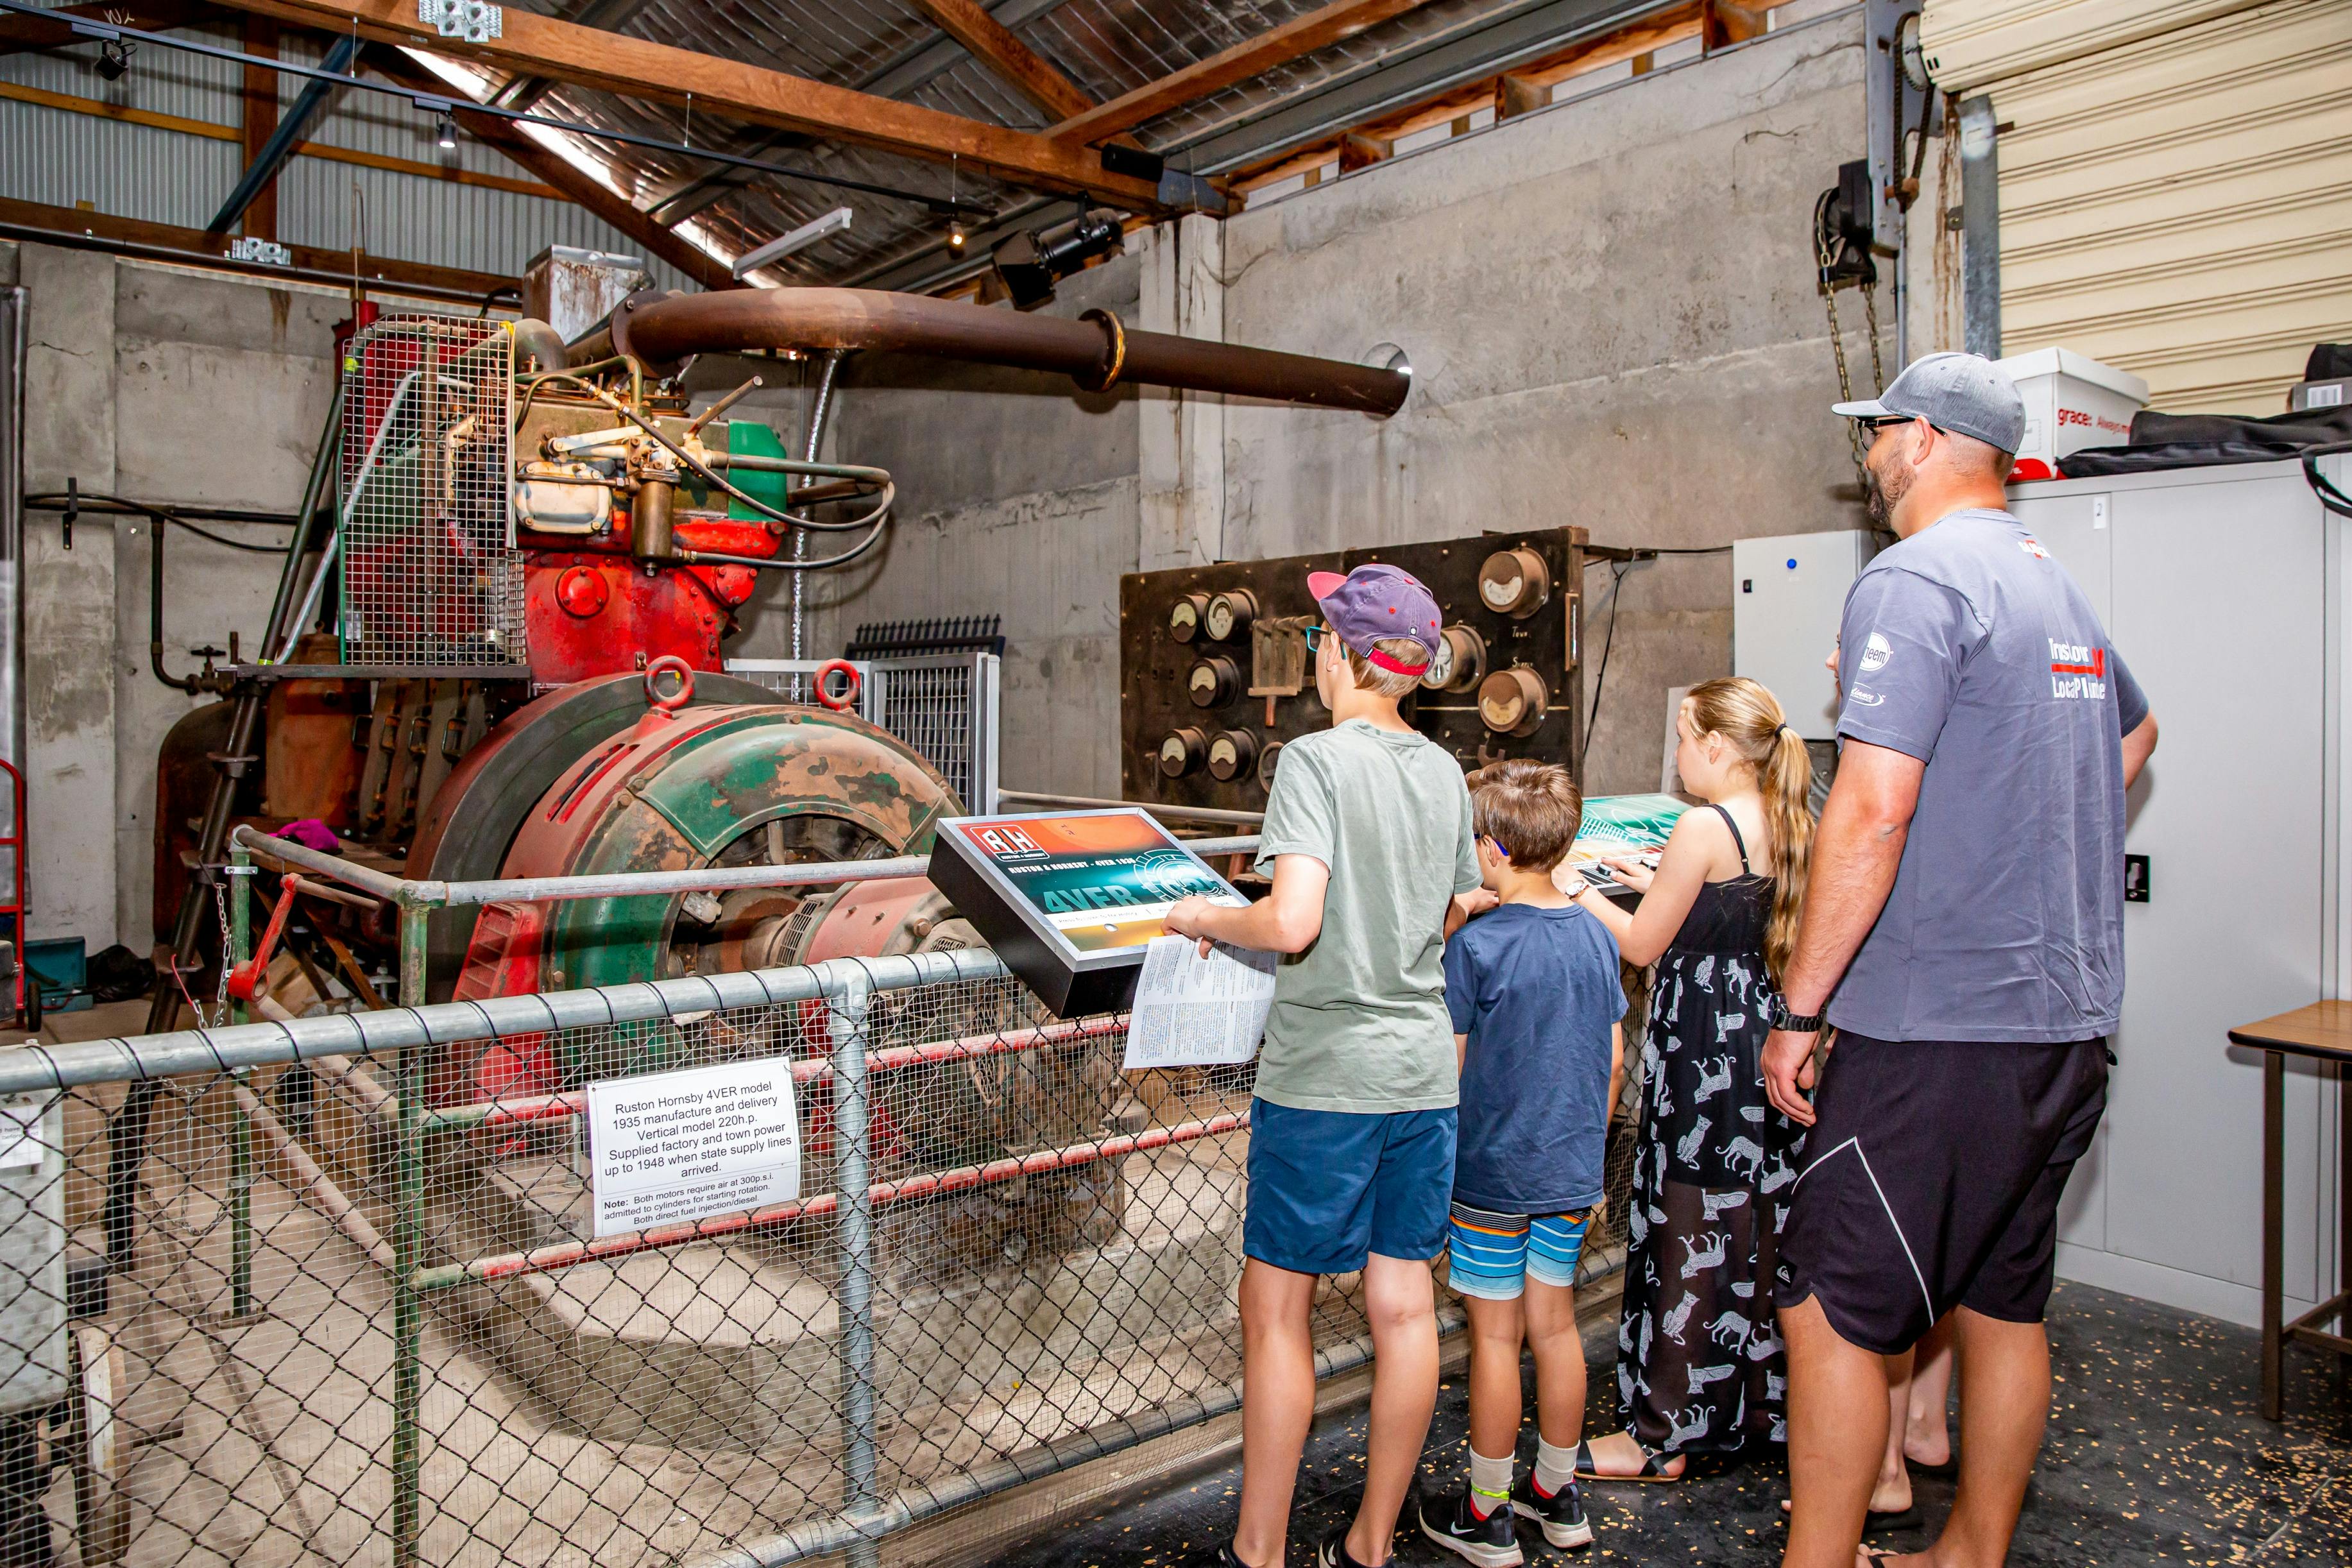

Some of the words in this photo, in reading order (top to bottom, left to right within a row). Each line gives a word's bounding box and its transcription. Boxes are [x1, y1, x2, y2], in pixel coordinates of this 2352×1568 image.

[1863, 646, 1886, 664] eem
[2052, 676, 2075, 699] Loca
[1007, 865, 1043, 874] RUSTON
[1050, 861, 1089, 871] HORNSBY
[1043, 885, 1143, 914] 4VER
[615, 1102, 654, 1114] Ruston
[658, 1093, 703, 1109] Hornsby
[706, 1087, 737, 1099] 4VER
[740, 1081, 772, 1095] model
[613, 1118, 641, 1130] 1935
[644, 1107, 712, 1125] manufacture
[715, 1102, 735, 1114] and
[738, 1096, 778, 1110] delivery
[637, 1128, 679, 1141] Vertical
[683, 1119, 715, 1134] model
[719, 1114, 758, 1128] 220h.p.
[604, 1165, 619, 1177] up
[622, 1163, 634, 1173] to
[637, 1157, 665, 1170] 1948
[668, 1152, 698, 1165] when
[701, 1146, 727, 1159] state
[730, 1141, 765, 1155] supply
[768, 1136, 792, 1148] lines
[609, 1146, 658, 1160] Supplied
[662, 1138, 699, 1154] factory
[703, 1132, 722, 1145] and
[726, 1129, 751, 1141] town
[754, 1124, 786, 1139] power
[681, 1162, 722, 1177] arrived.
[604, 1199, 629, 1209] Note:
[634, 1194, 653, 1204] Both
[656, 1189, 685, 1200] motors
[687, 1183, 715, 1195] require
[604, 1207, 641, 1220] admitted
[654, 1198, 691, 1211] cylinders
[693, 1195, 704, 1204] for
[706, 1191, 735, 1203] starting
[738, 1184, 771, 1195] rotation.
[634, 1216, 653, 1225] Both
[656, 1210, 679, 1221] direct
[681, 1207, 695, 1216] fuel
[698, 1195, 760, 1213] injection/diesel.
